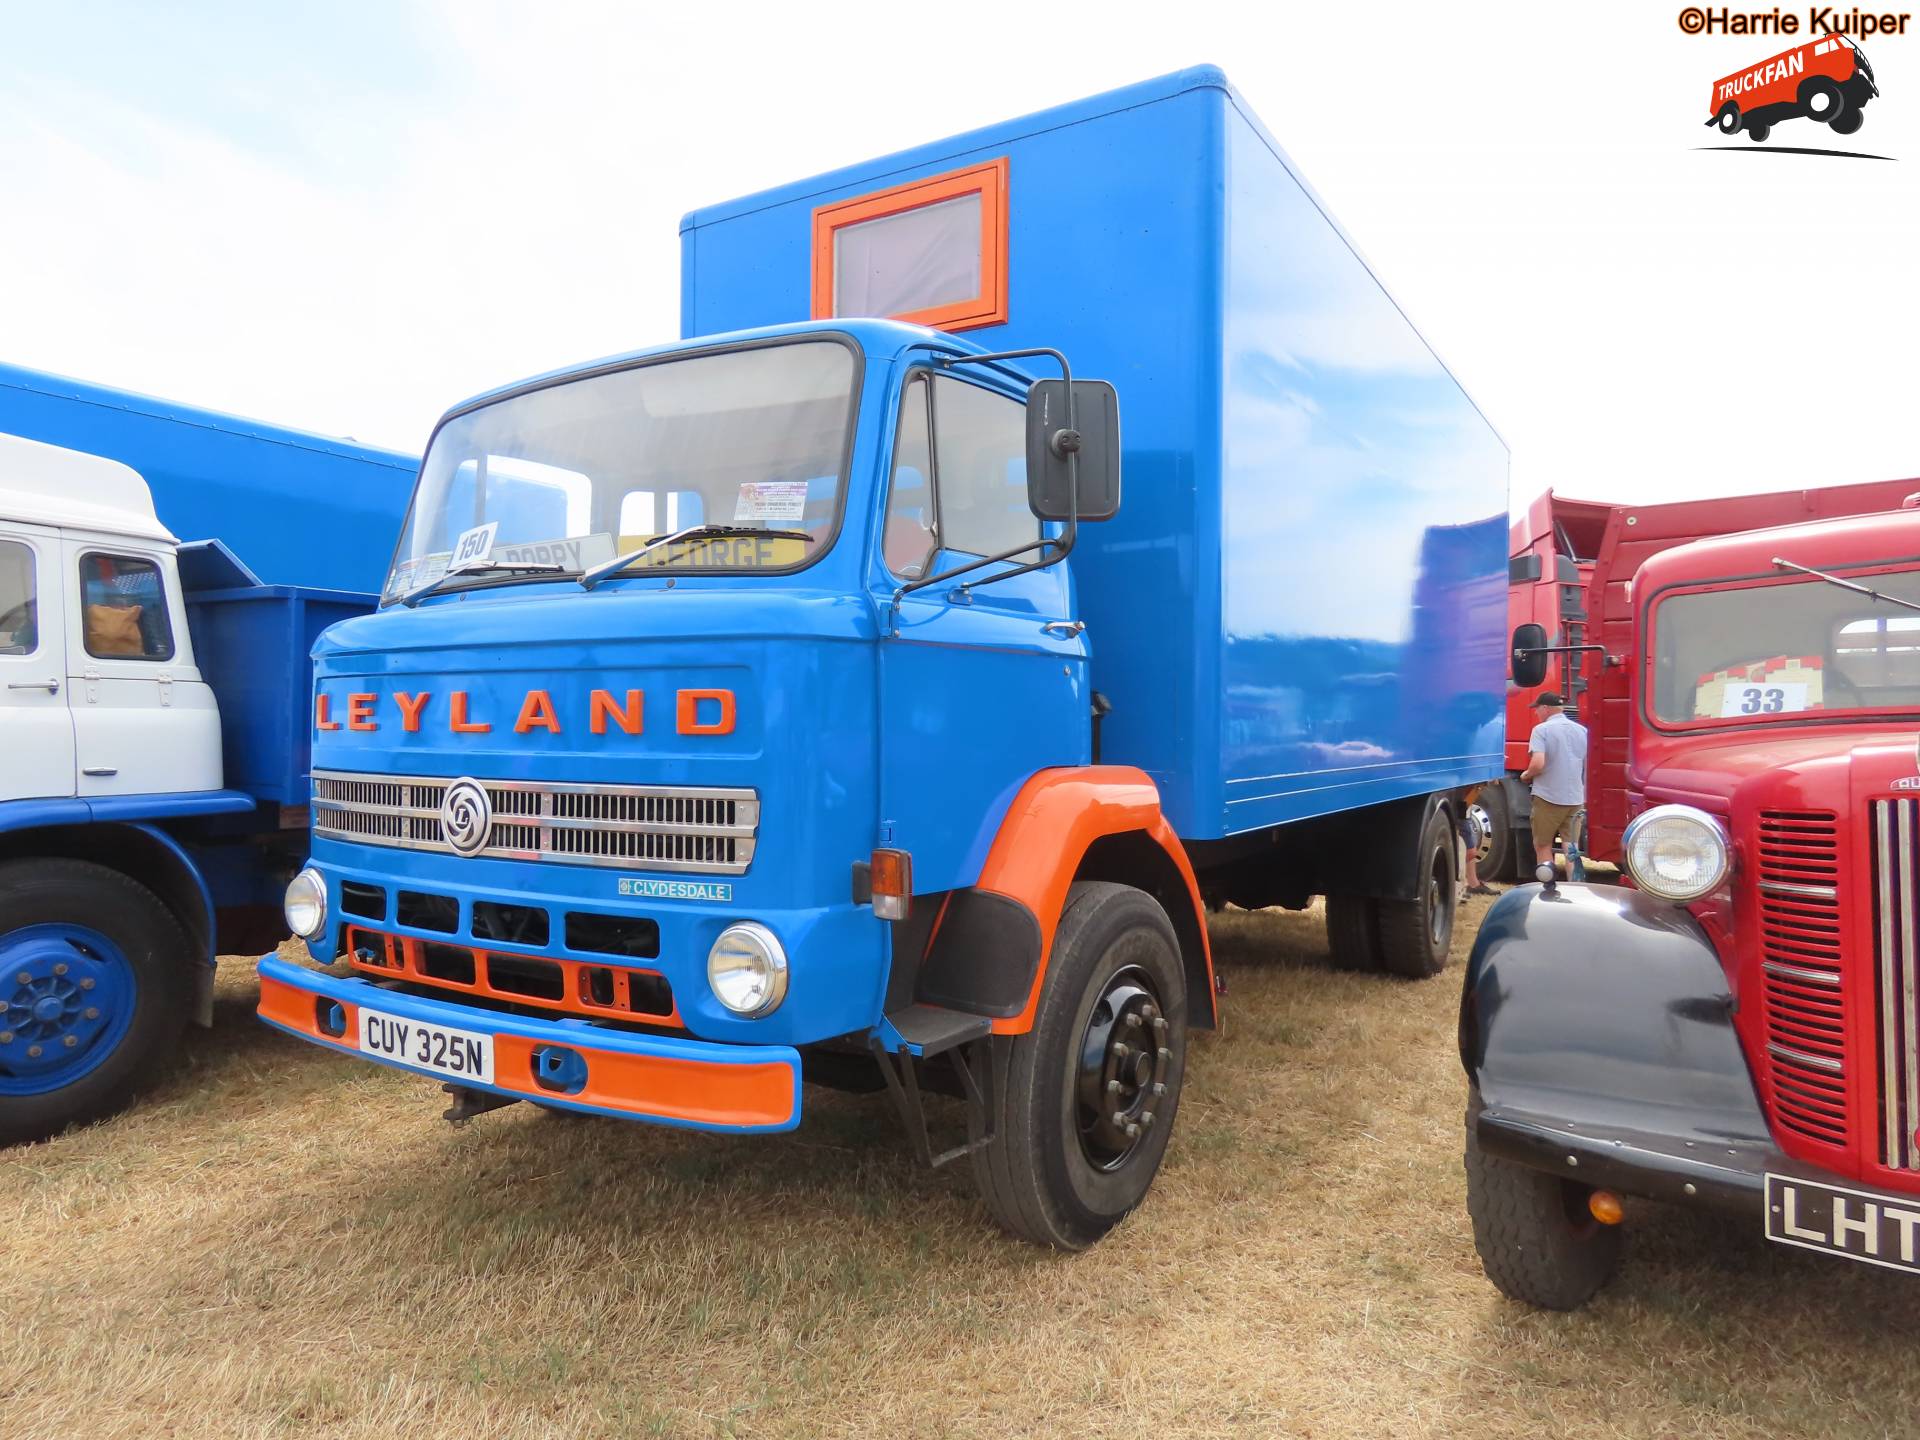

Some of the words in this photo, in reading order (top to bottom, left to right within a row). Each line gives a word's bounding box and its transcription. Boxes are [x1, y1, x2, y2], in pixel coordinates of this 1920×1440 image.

[458, 528, 490, 562] 150
[315, 688, 737, 735] LEYLAND
[1740, 688, 1785, 714] 33
[633, 881, 725, 899] CLYDESDALE
[367, 1015, 409, 1057] CUY
[416, 1028, 482, 1077] 325N
[1783, 1186, 1920, 1263] LHT
